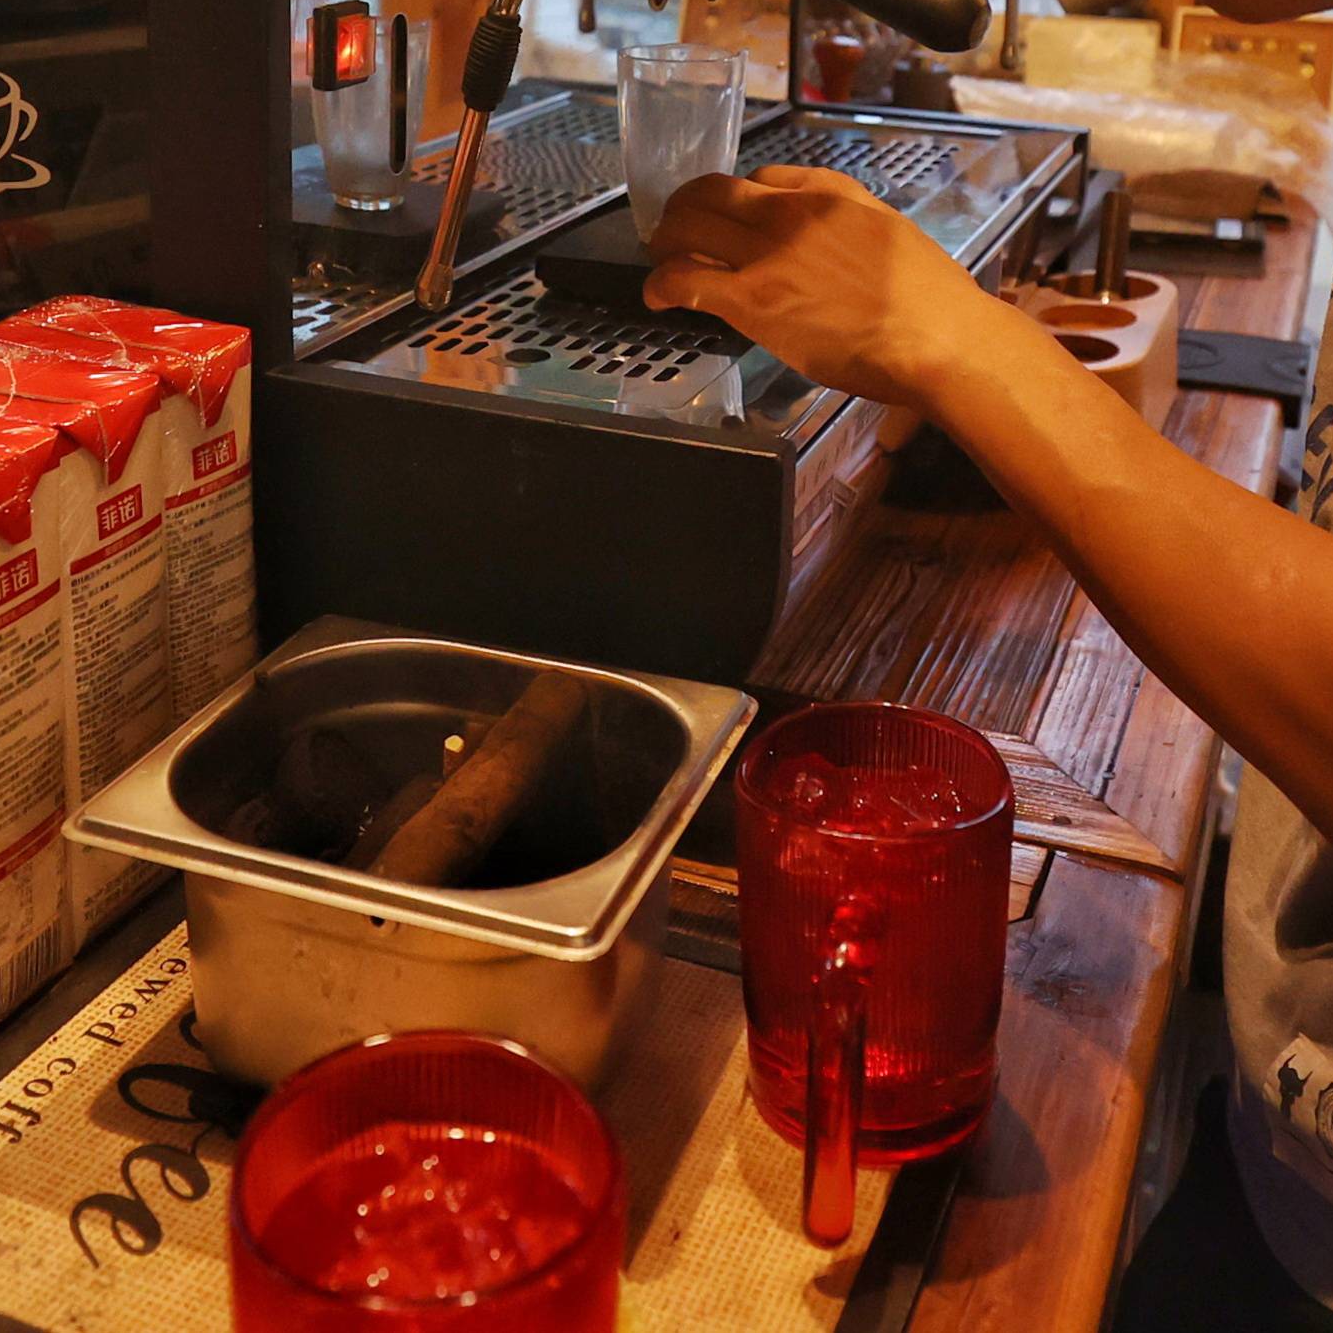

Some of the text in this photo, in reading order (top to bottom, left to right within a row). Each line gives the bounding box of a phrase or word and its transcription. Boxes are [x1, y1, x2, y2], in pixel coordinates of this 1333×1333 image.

[196, 439, 230, 473] 菲诺
[100, 493, 136, 532] 菲诺
[78, 942, 189, 1047] ewed
